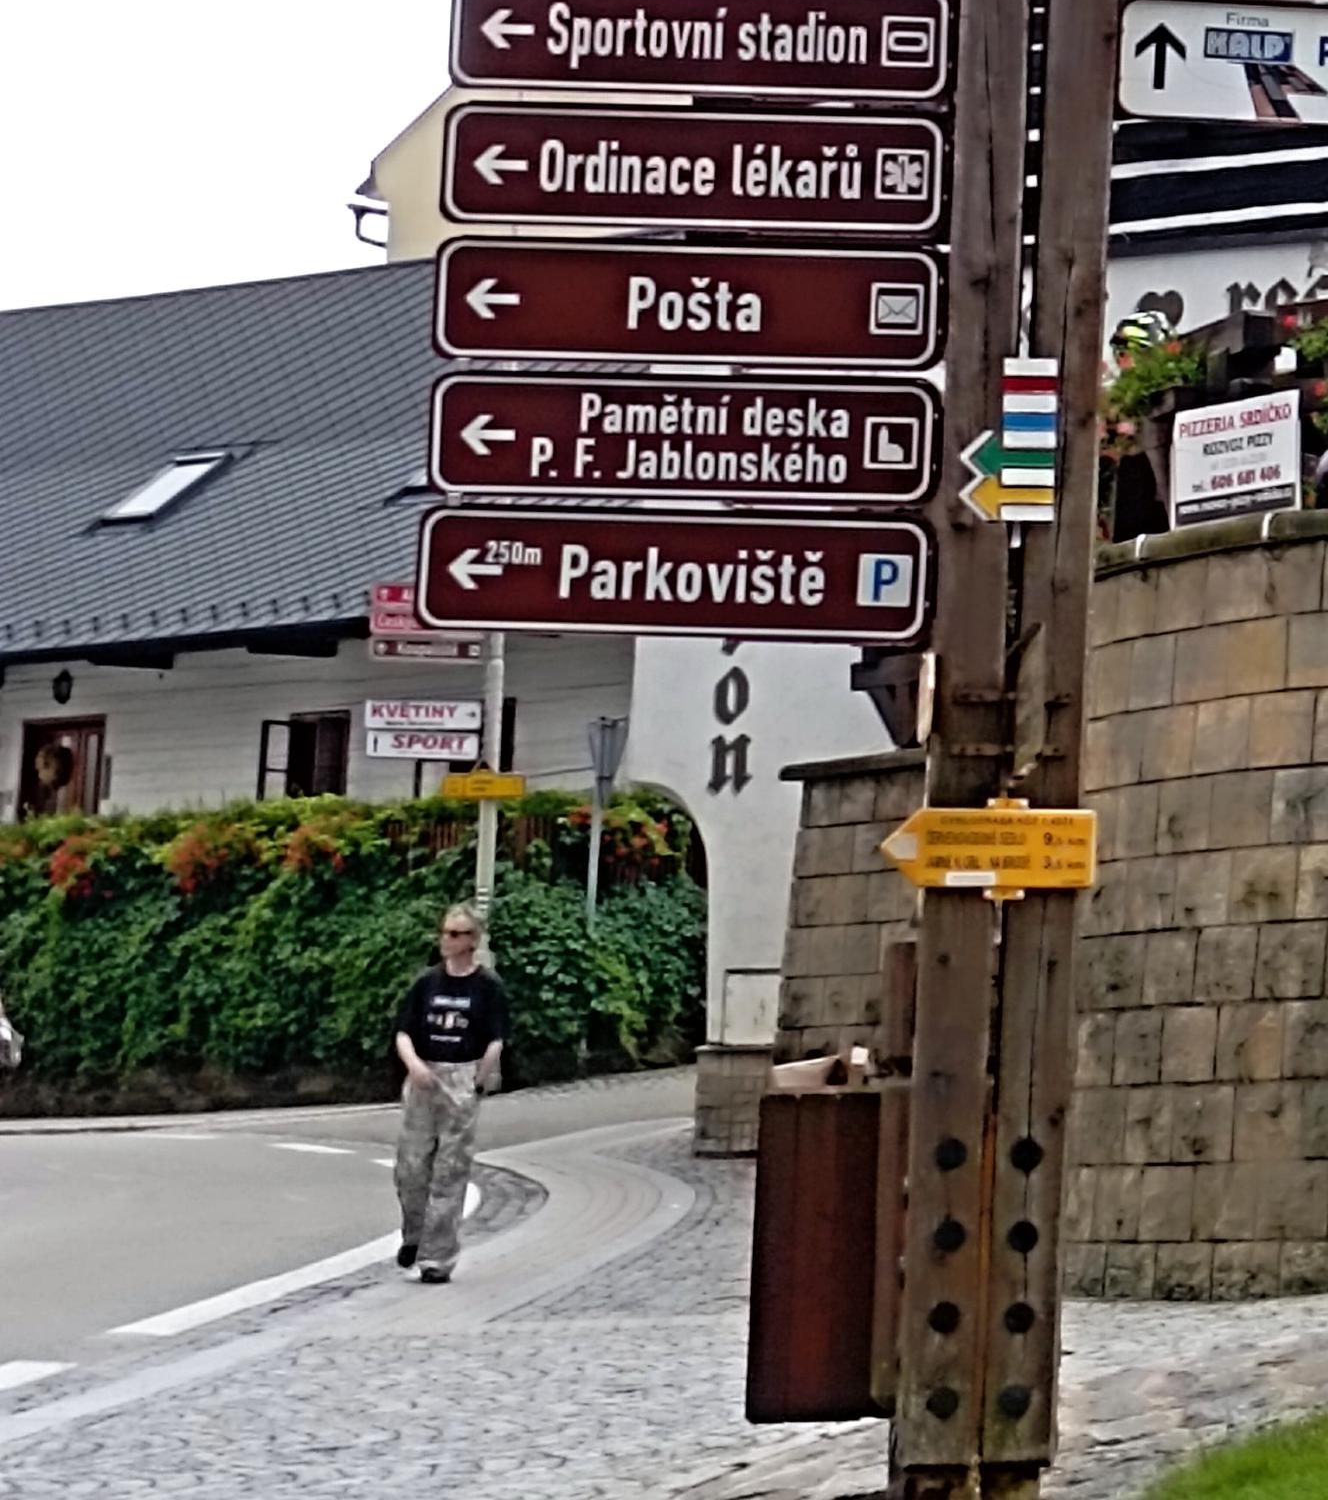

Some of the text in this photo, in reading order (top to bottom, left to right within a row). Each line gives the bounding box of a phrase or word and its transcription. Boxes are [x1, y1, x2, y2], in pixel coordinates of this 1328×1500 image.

[547, 3, 867, 69] Sportovní stadion
[1226, 12, 1269, 27] Firma
[539, 141, 862, 200] Ordinace lékařů
[627, 276, 762, 333] Pošta
[580, 392, 849, 439] Pamětní deska
[1179, 415, 1236, 439] PIZZERIA
[531, 437, 848, 484] P. F. Jablonského
[484, 541, 898, 606] 250m Parkoviště P
[371, 702, 458, 718] KVĚTINY
[391, 733, 470, 750] SPORT
